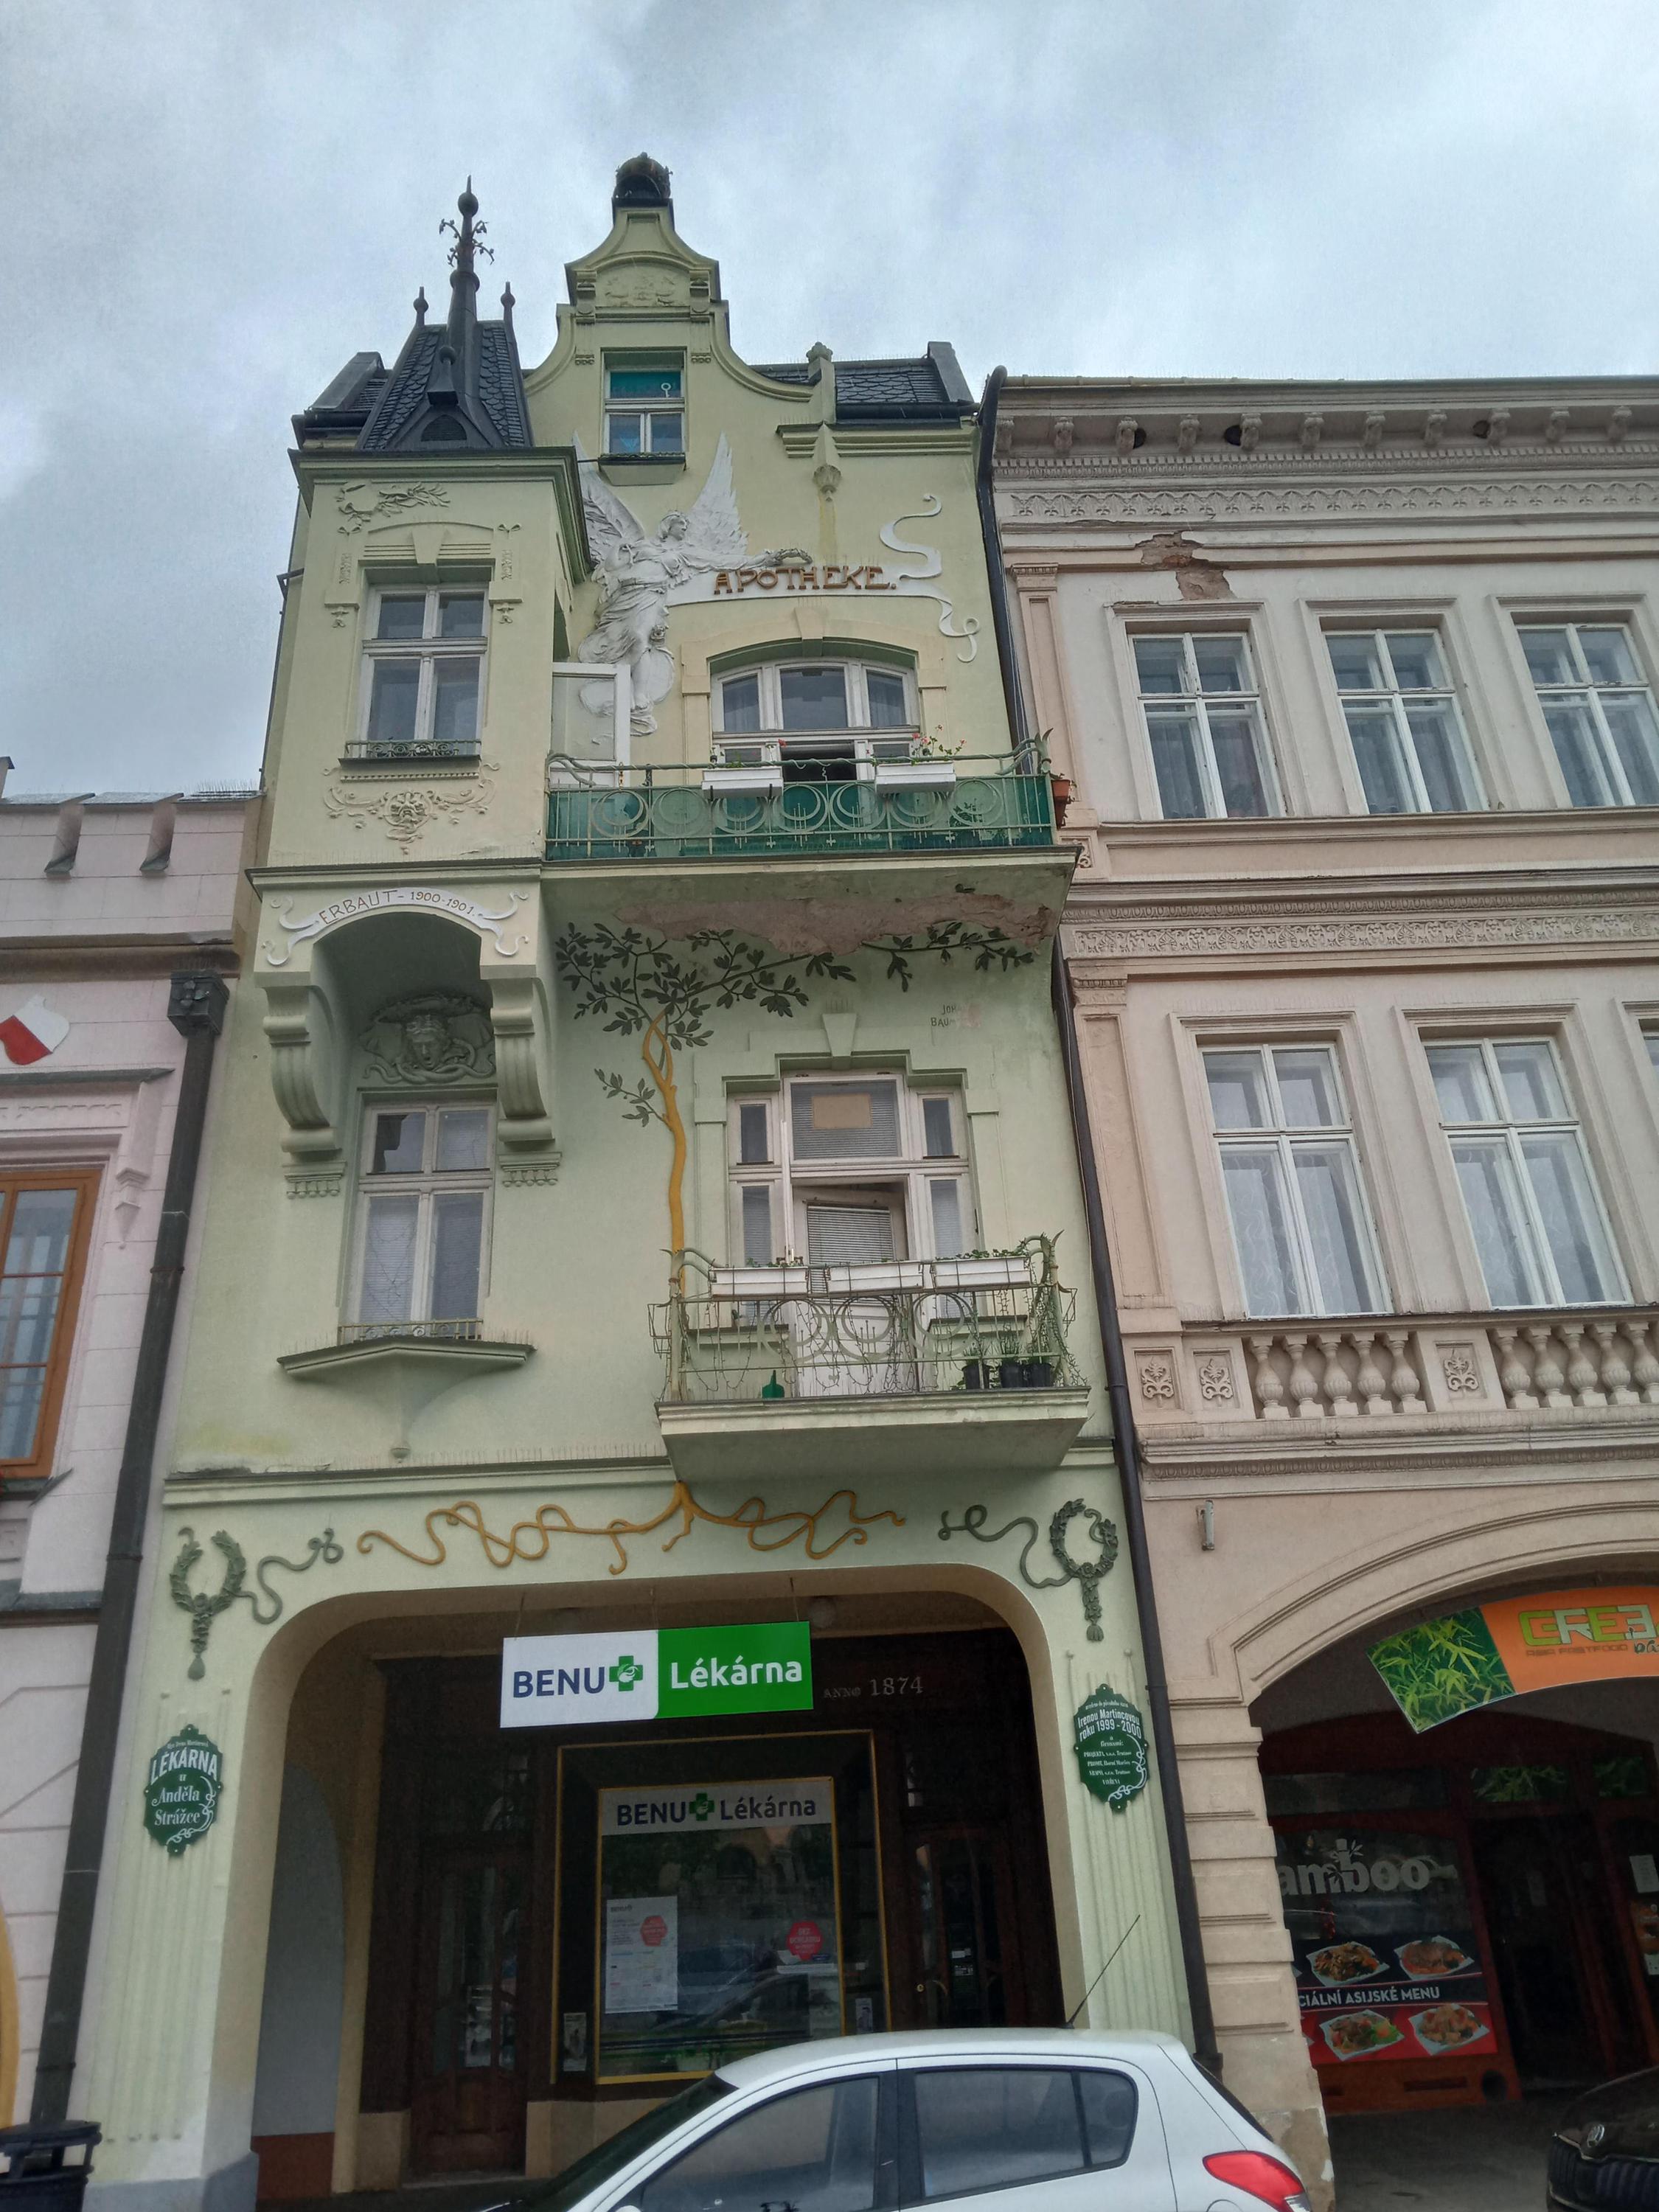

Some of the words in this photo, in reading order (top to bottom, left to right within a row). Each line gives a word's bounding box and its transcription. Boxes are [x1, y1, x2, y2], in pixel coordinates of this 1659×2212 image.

[1518, 1604, 1659, 1646] GREE
[512, 1666, 605, 1699] BENU
[670, 1655, 803, 1690] Lékárna
[824, 1687, 861, 1699] ANNO
[869, 1676, 924, 1696] 1874
[1077, 1712, 1099, 1728] Irenou
[1099, 1708, 1140, 1725] Martincovou
[1079, 1725, 1096, 1742] roku
[1096, 1719, 1115, 1732] 1999
[1121, 1720, 1142, 1739] 2000
[150, 1747, 218, 1786] LÉKÁRNA
[151, 1785, 200, 1807] Anděla
[154, 1808, 201, 1826] Strážce
[617, 1801, 686, 1826] BENU
[720, 1795, 816, 1820] Lékárna
[1345, 1986, 1399, 2004] ASIJSKÉ
[1401, 1986, 1439, 2000] MENU
